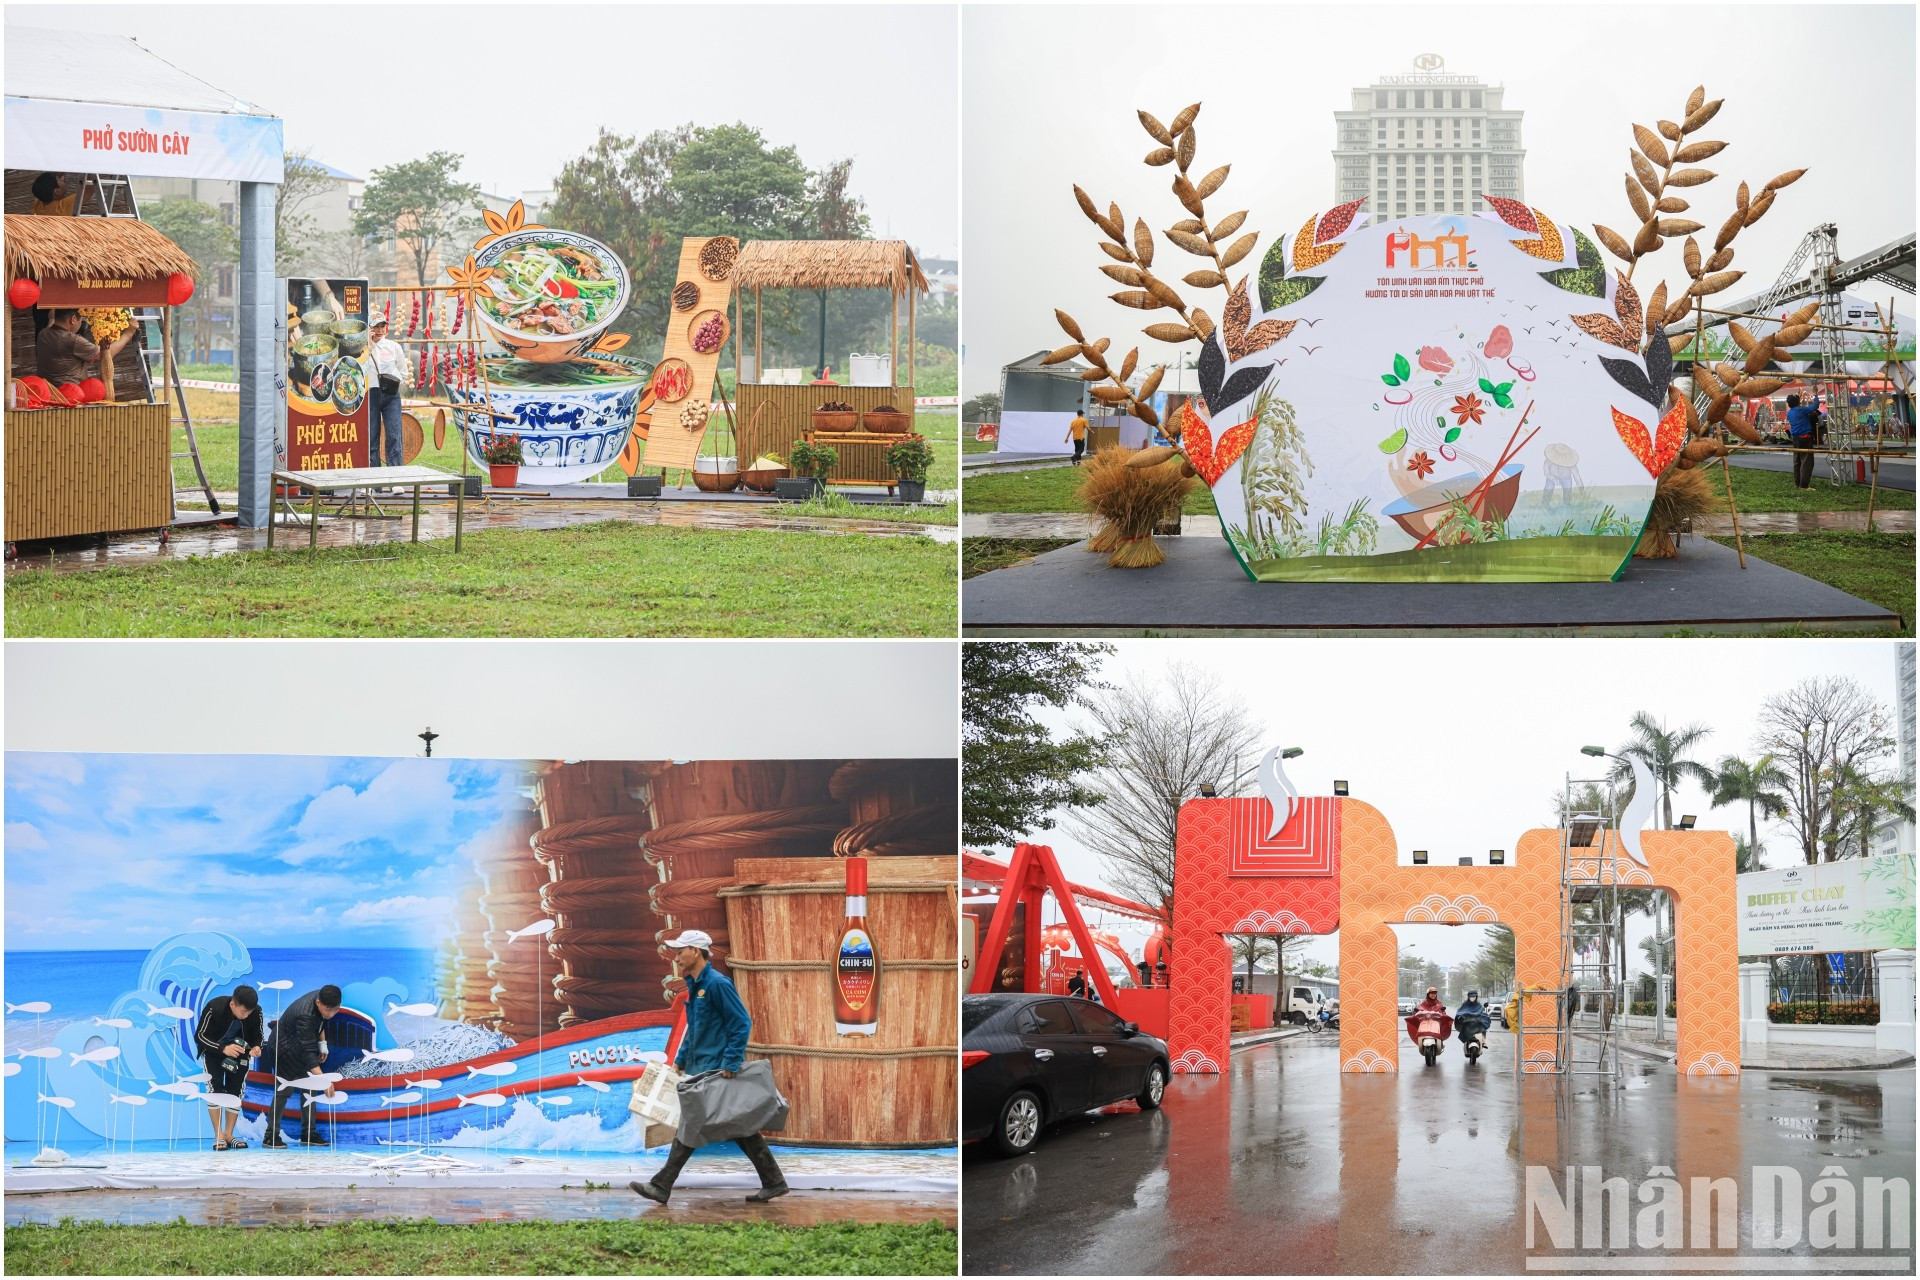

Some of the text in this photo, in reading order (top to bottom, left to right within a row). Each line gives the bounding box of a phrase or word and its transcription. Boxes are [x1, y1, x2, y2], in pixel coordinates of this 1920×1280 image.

[1380, 75, 1405, 84] NAM
[1445, 75, 1479, 84] HOTEL
[83, 124, 190, 155] PHỞ SƯỜN CÂY
[1455, 289, 1466, 298] PHI
[296, 418, 326, 446] PHỞ
[328, 420, 358, 443] XƯA
[1747, 885, 1846, 907] BUFFET CHAY
[840, 958, 873, 967] CHIN-SU
